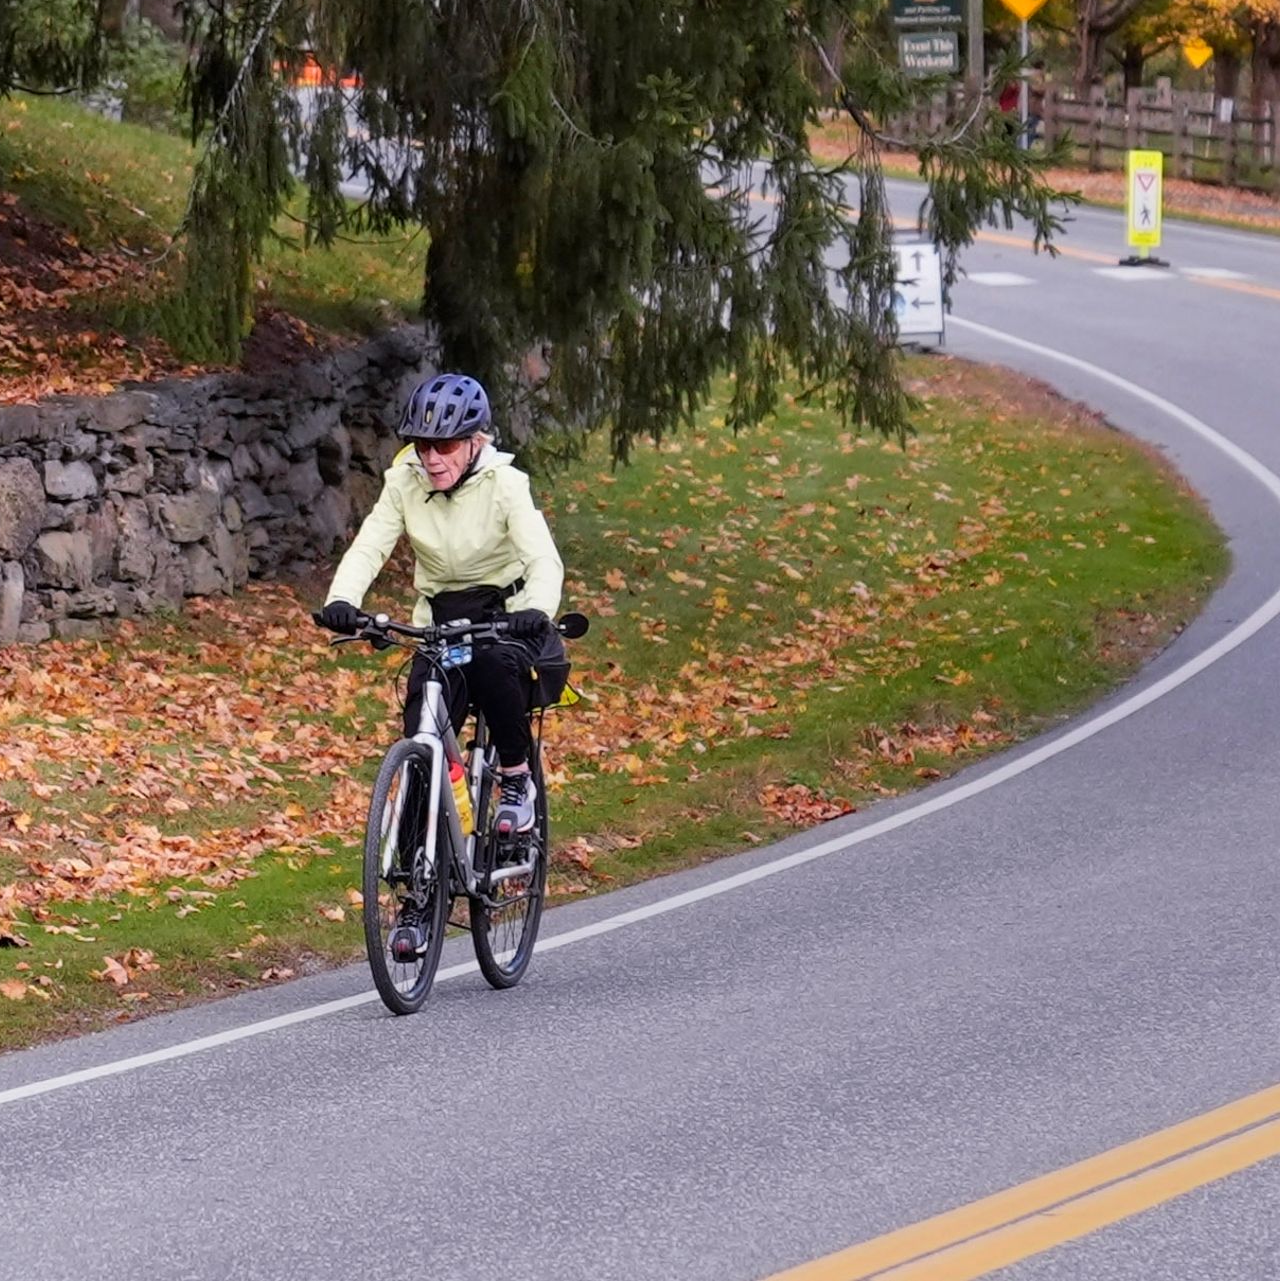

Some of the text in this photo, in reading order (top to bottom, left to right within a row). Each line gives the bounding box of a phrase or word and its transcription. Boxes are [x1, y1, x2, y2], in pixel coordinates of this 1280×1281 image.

[904, 39, 954, 53] Event This
[905, 54, 953, 67] Weekend
